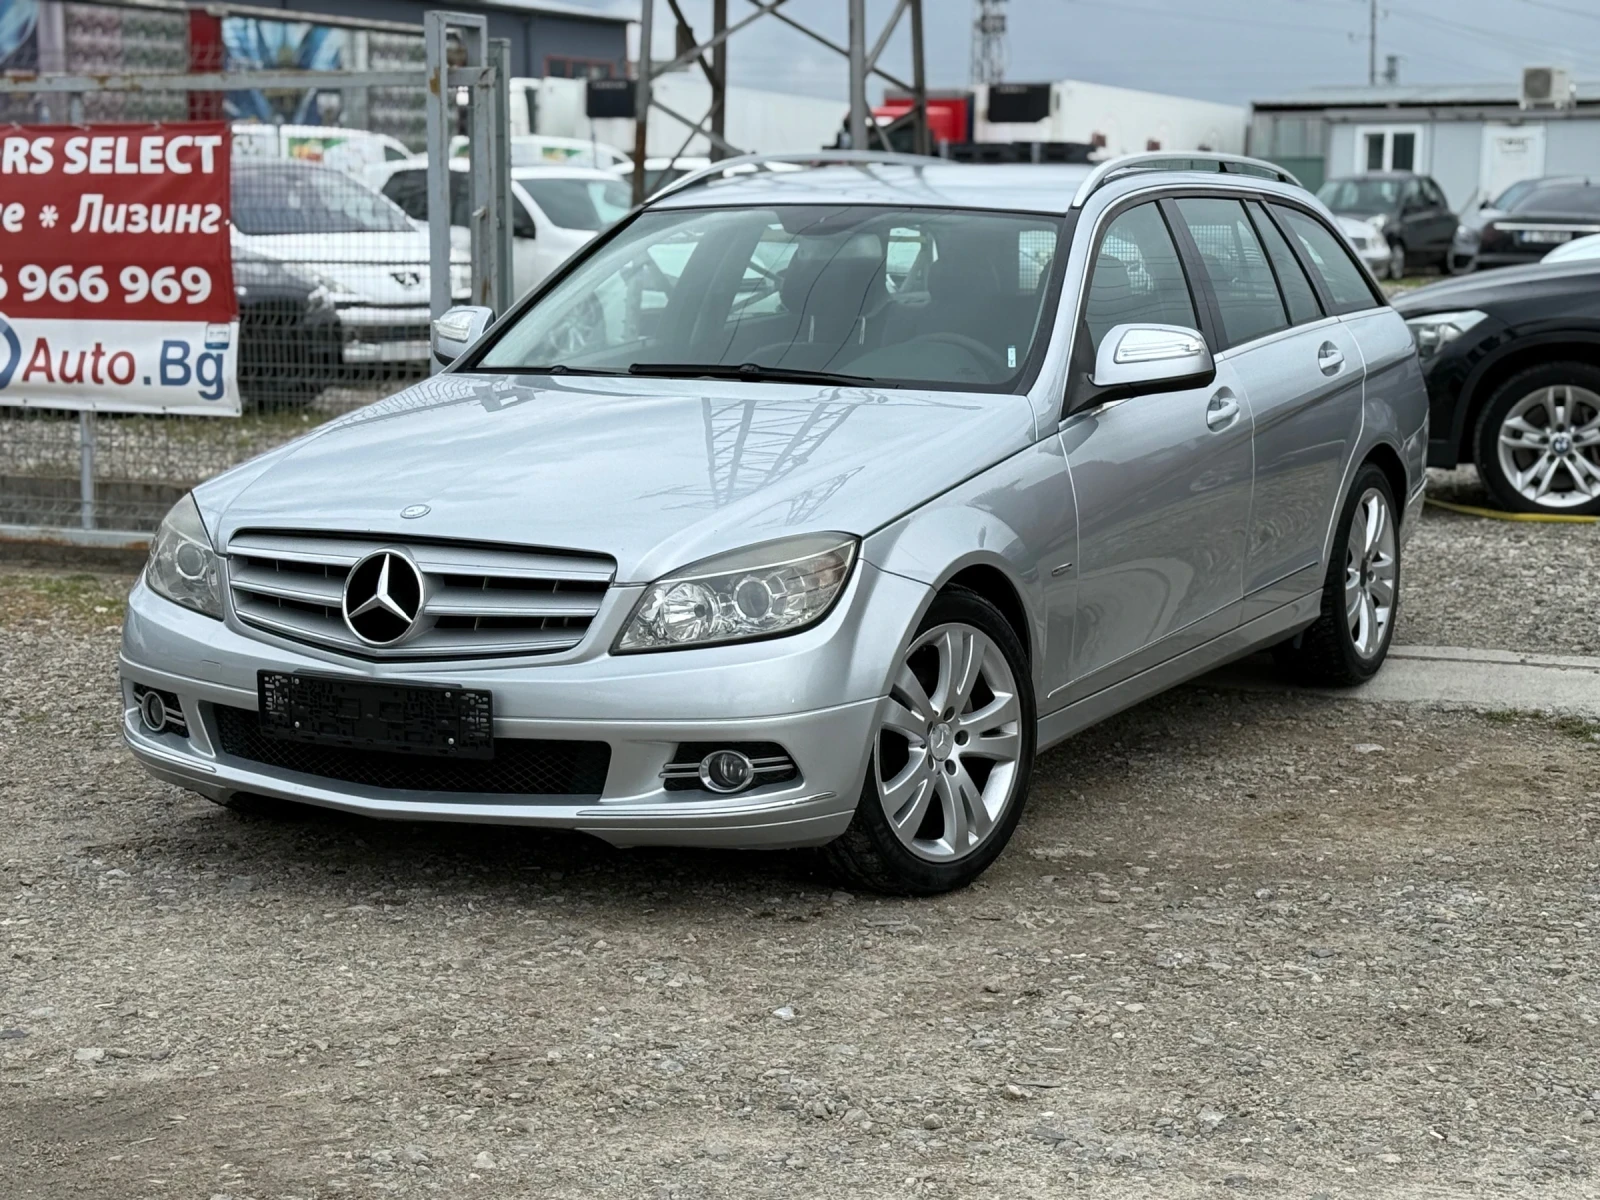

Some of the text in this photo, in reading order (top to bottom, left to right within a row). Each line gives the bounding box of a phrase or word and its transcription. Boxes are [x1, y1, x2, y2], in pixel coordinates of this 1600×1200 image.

[0, 135, 223, 175] RS SELECT
[70, 193, 223, 234] Лизинг
[18, 263, 110, 303] 966
[119, 265, 213, 305] 969
